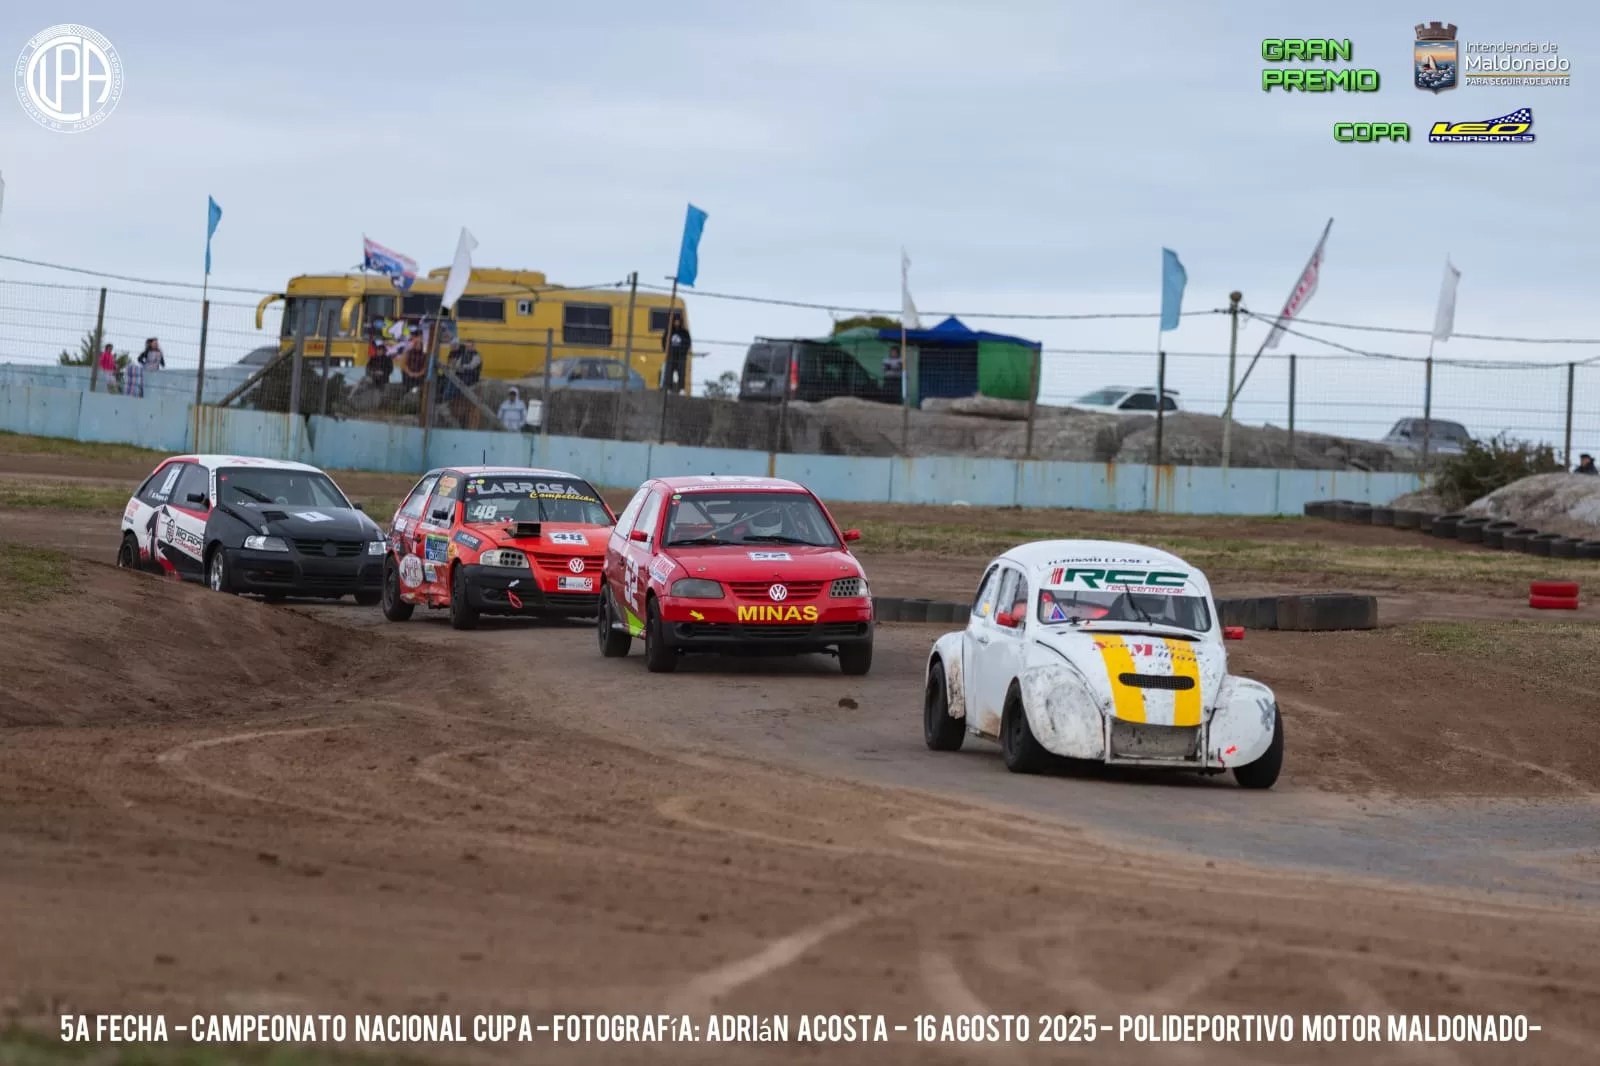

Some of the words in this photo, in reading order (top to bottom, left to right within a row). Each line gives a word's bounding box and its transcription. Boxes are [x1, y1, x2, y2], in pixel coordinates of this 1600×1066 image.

[475, 482, 581, 496] LARROSA
[474, 504, 498, 520] 48
[1064, 568, 1189, 589] RCC
[738, 605, 818, 621] MINAS
